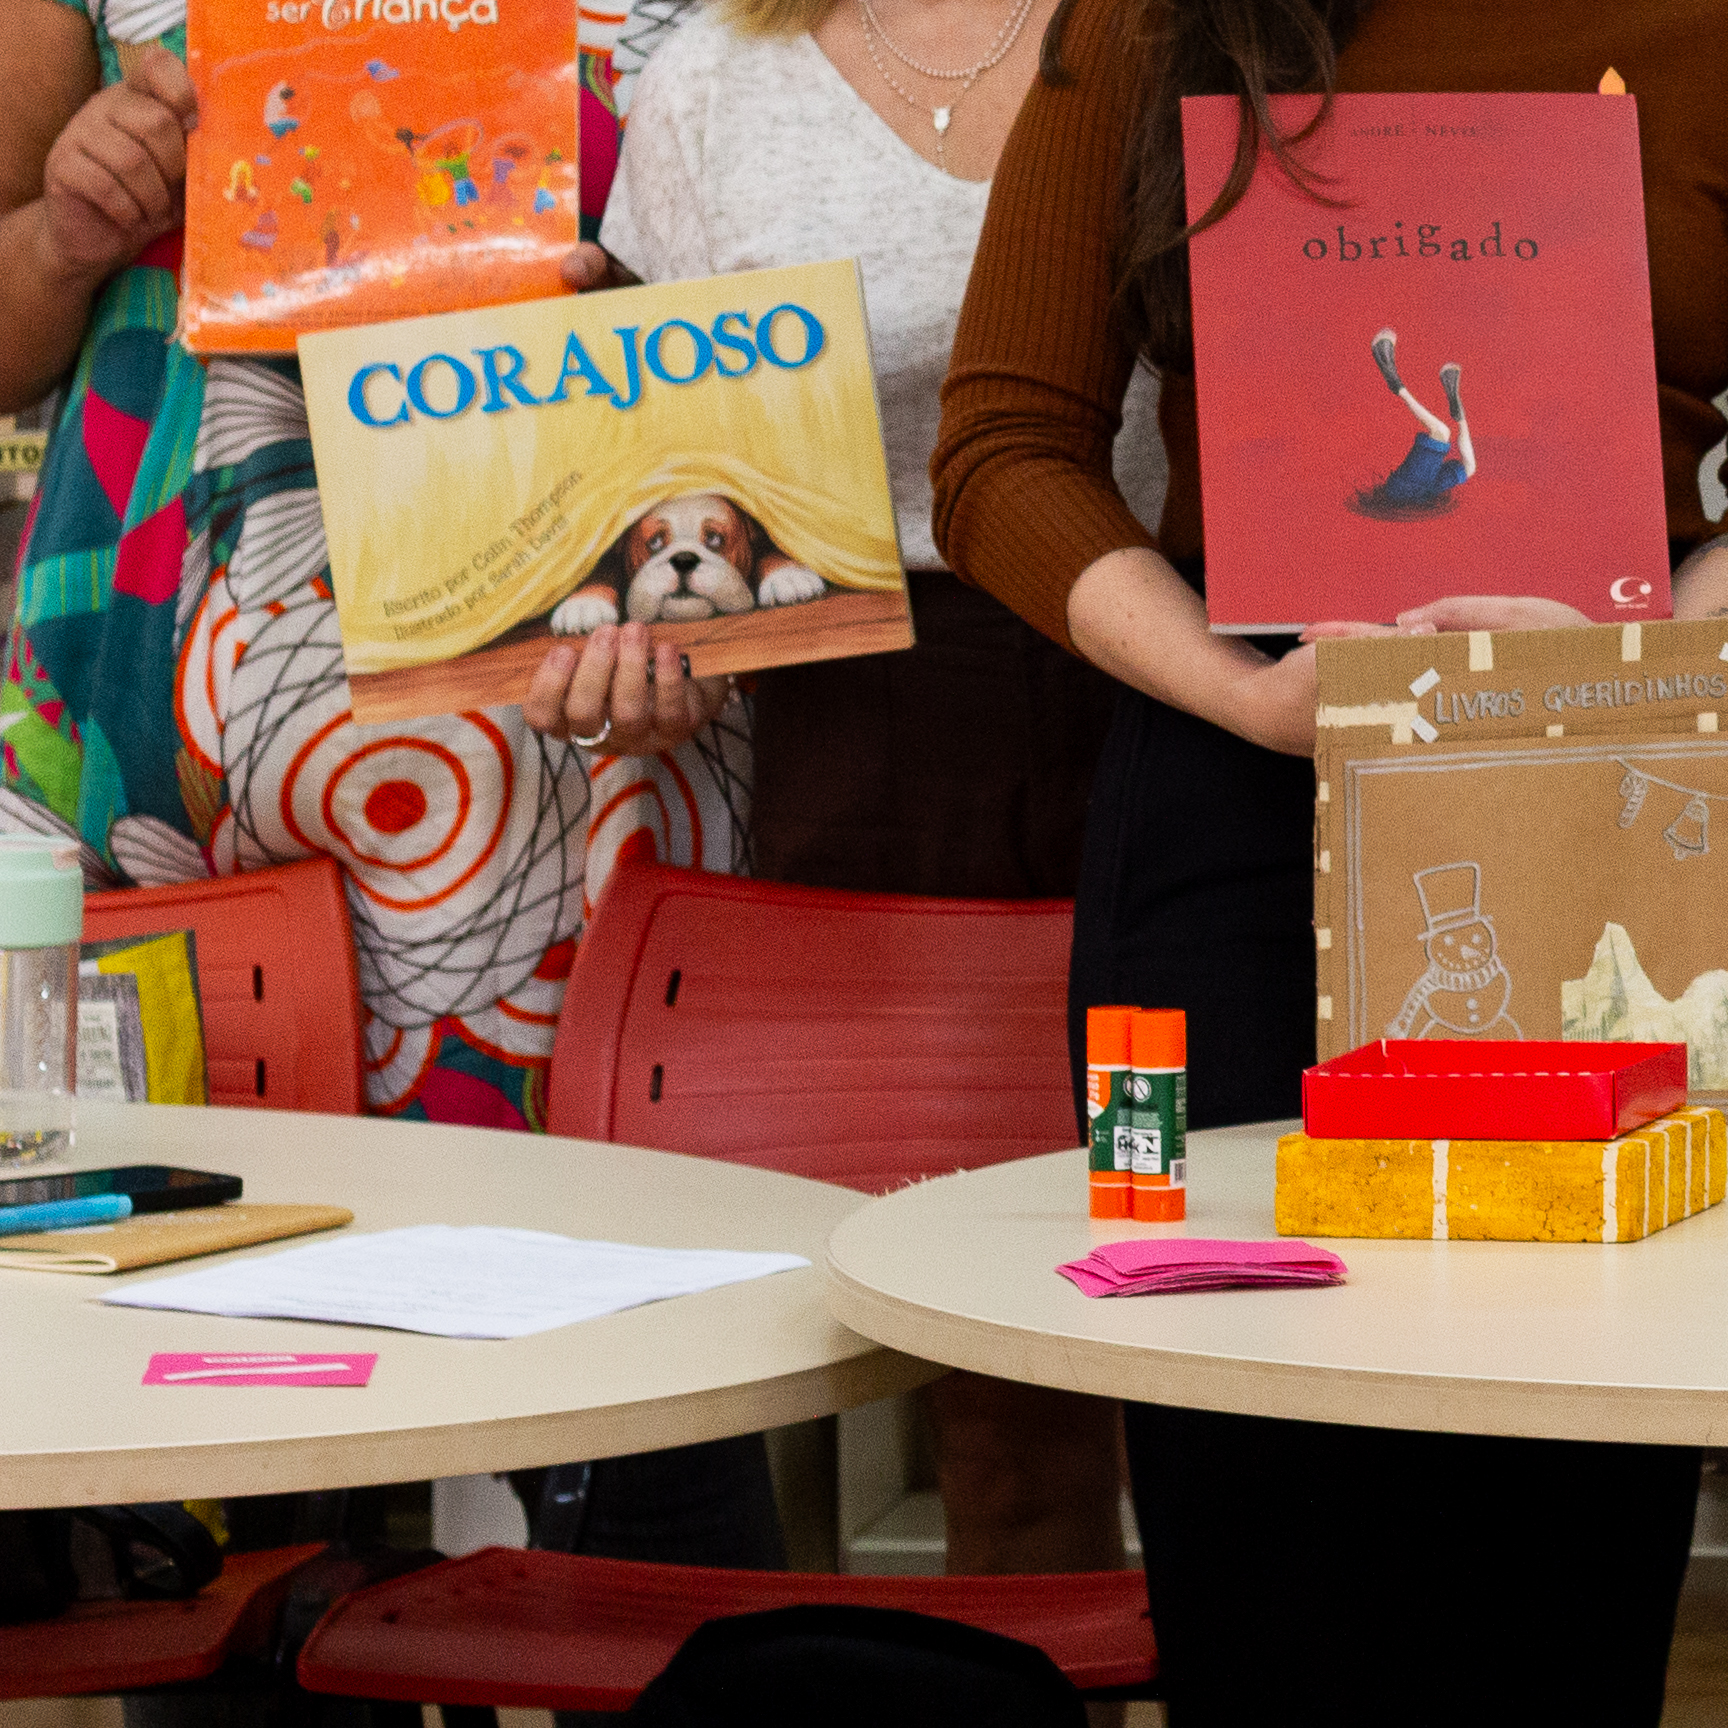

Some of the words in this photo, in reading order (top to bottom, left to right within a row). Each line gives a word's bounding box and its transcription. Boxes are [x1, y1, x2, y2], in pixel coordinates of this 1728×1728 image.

[265, 0, 312, 24] ser
[1301, 220, 1541, 262] obrigado
[346, 302, 827, 429] CORAJOSO
[1434, 685, 1526, 726] LIVROS
[1542, 672, 1728, 715] QUERIDINHOS
